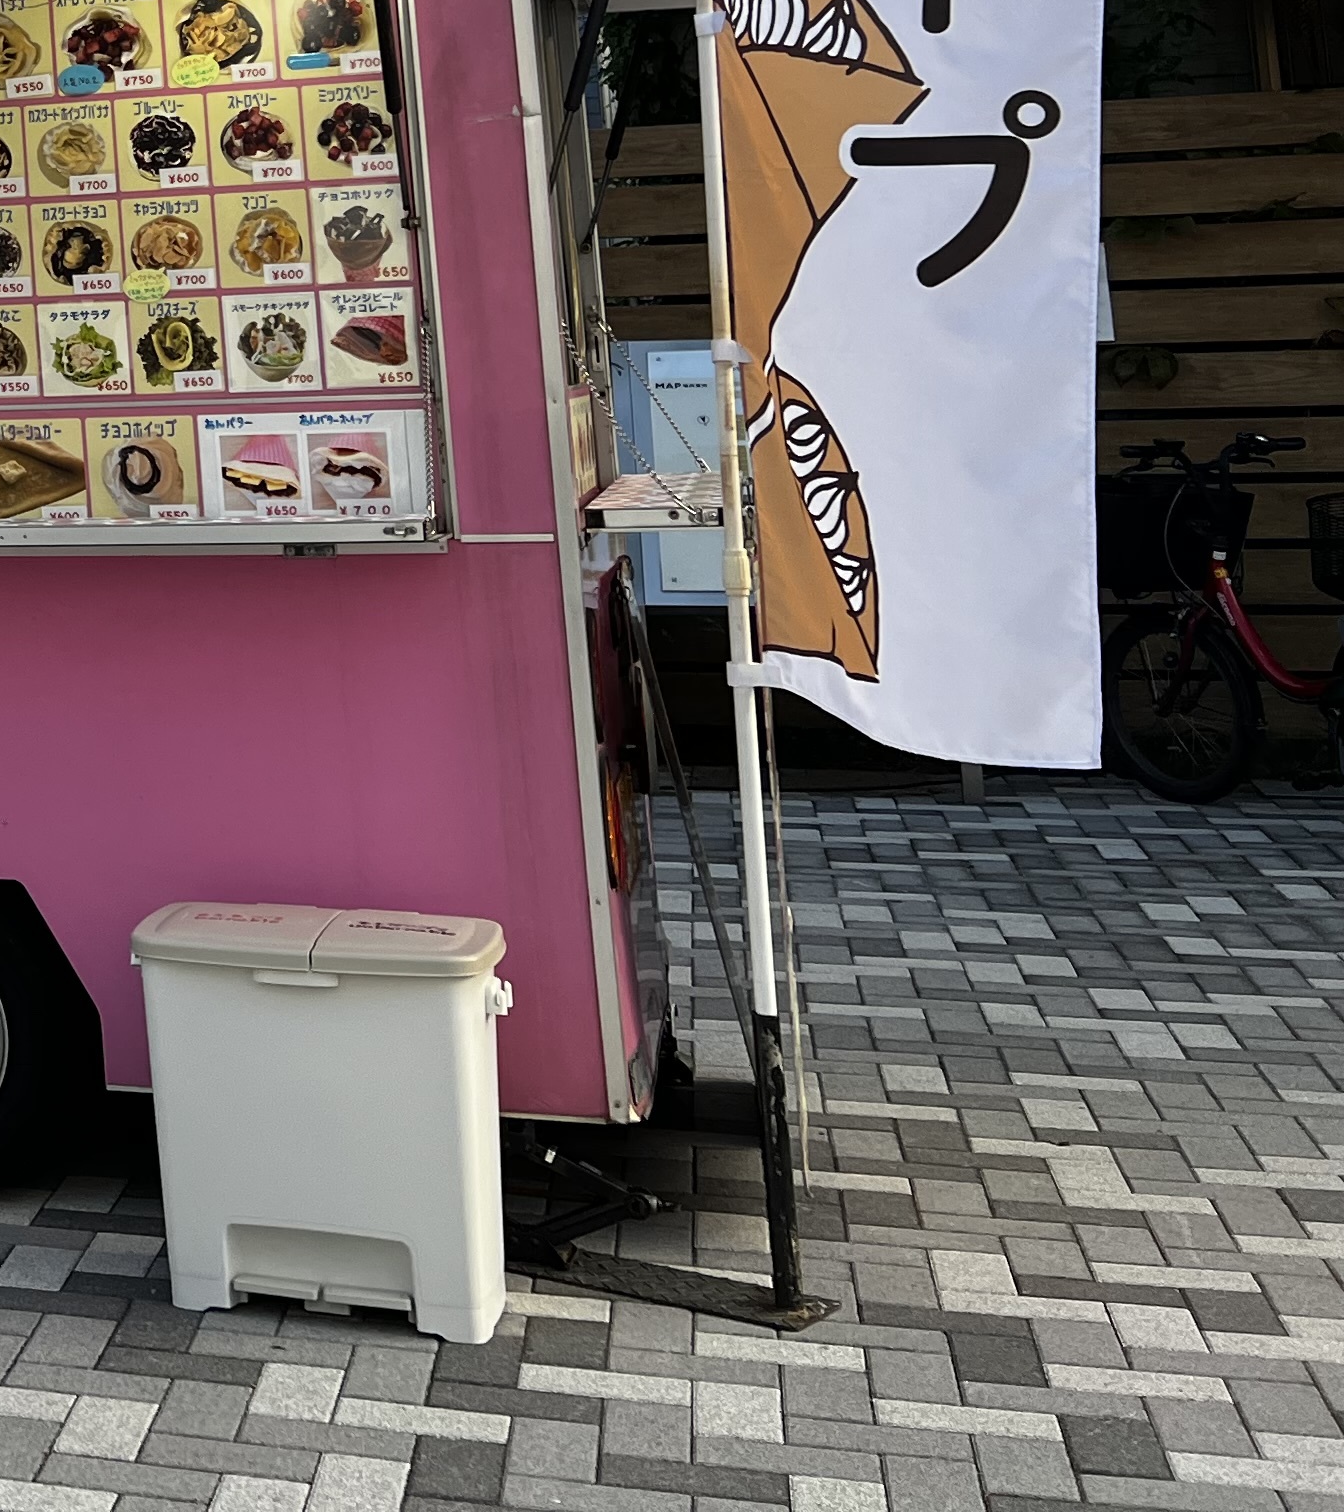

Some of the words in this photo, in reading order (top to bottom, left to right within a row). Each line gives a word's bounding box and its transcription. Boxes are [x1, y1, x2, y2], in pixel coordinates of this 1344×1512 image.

[349, 58, 381, 69] ¥700
[238, 67, 267, 78] ¥700
[14, 80, 44, 93] ¥550
[123, 74, 154, 87] ¥750
[227, 92, 278, 109] ストロベリー
[318, 85, 379, 103] ミックスベリー
[28, 104, 110, 123] カスタードホイップバナナ
[132, 100, 185, 116] ブルーベリー
[262, 166, 293, 178] ¥700
[362, 160, 394, 172] ¥600
[168, 172, 200, 184] ¥600
[78, 179, 108, 191] ¥700
[317, 187, 395, 202] チョコホリック
[133, 199, 200, 216] キャラメルナッツ
[242, 194, 278, 210] マンゴー
[42, 204, 107, 222] カスタードチョコ
[175, 274, 207, 286] ¥700
[272, 268, 304, 281] ¥600
[82, 279, 112, 291] ¥650
[331, 292, 404, 305] オレンジピール
[147, 300, 200, 318] レタスチーズ
[231, 300, 310, 313] スモークチキンサラダ
[337, 302, 398, 314] チョコレート
[49, 308, 111, 323] タラモサラダ
[183, 375, 214, 387] ¥650
[378, 371, 413, 384] ¥650
[0, 381, 30, 393] ¥550
[97, 380, 128, 392] ¥650
[100, 420, 178, 439] チョコホイップ
[265, 505, 298, 517] ¥650
